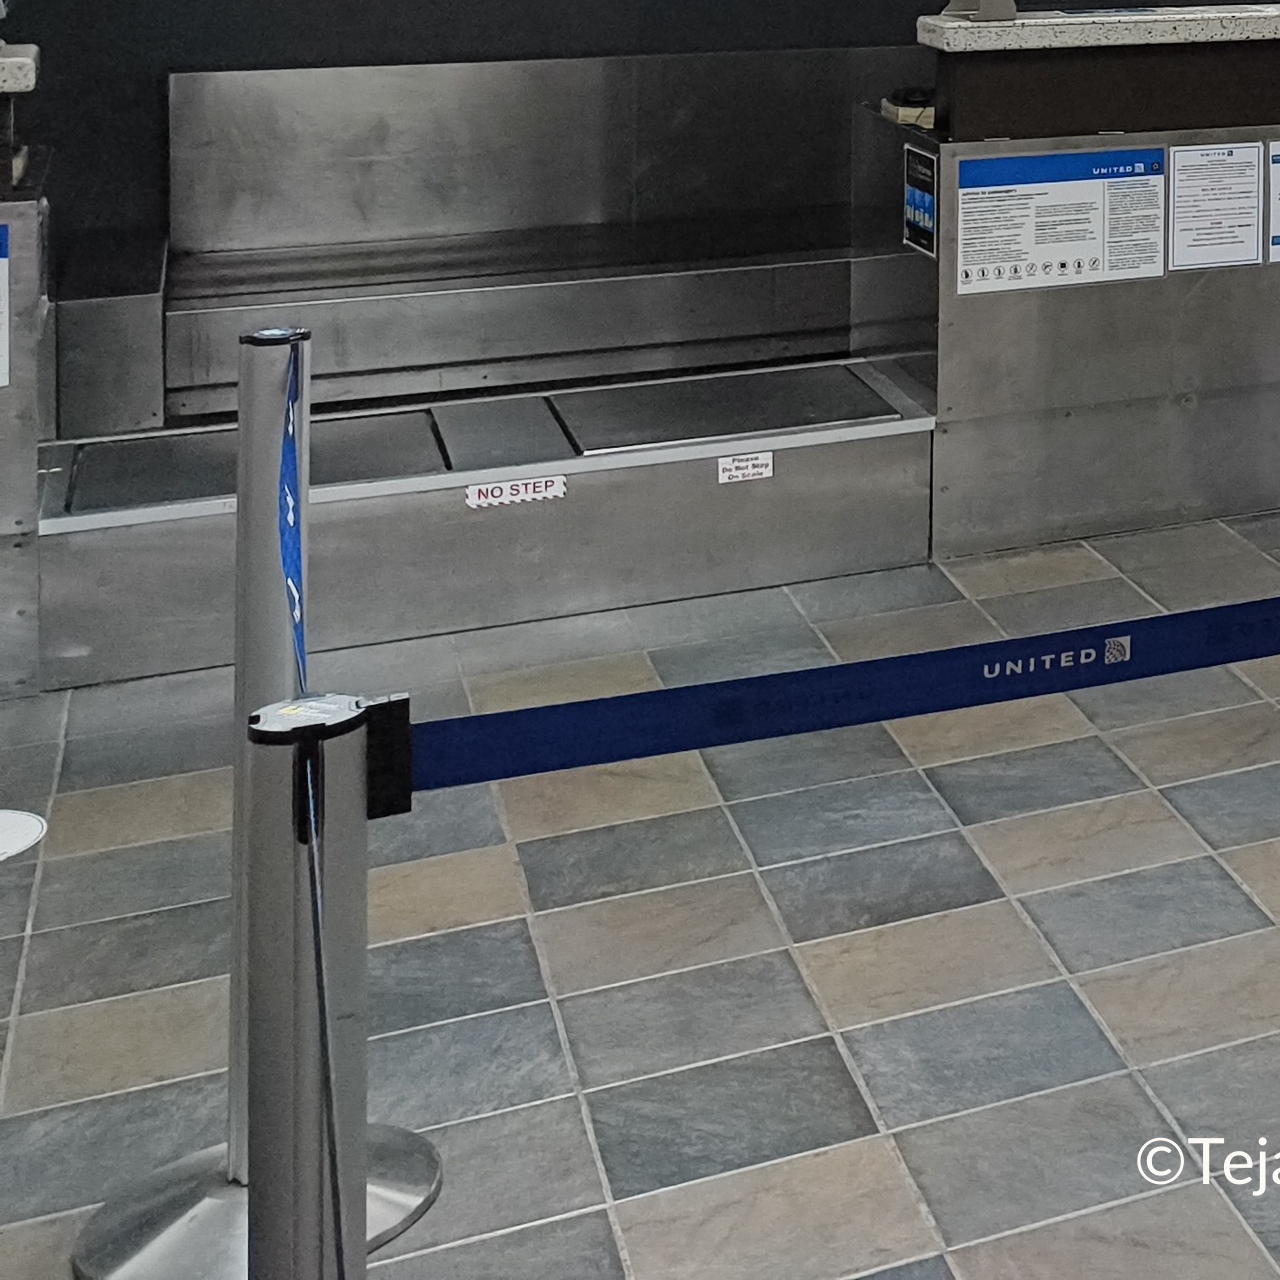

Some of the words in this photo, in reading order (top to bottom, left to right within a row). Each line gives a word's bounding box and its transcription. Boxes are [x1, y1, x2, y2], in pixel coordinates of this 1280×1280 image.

[1092, 165, 1133, 175] UNITED
[477, 486, 503, 500] NO
[510, 480, 555, 496] STEP
[983, 648, 1096, 678] UNITED
